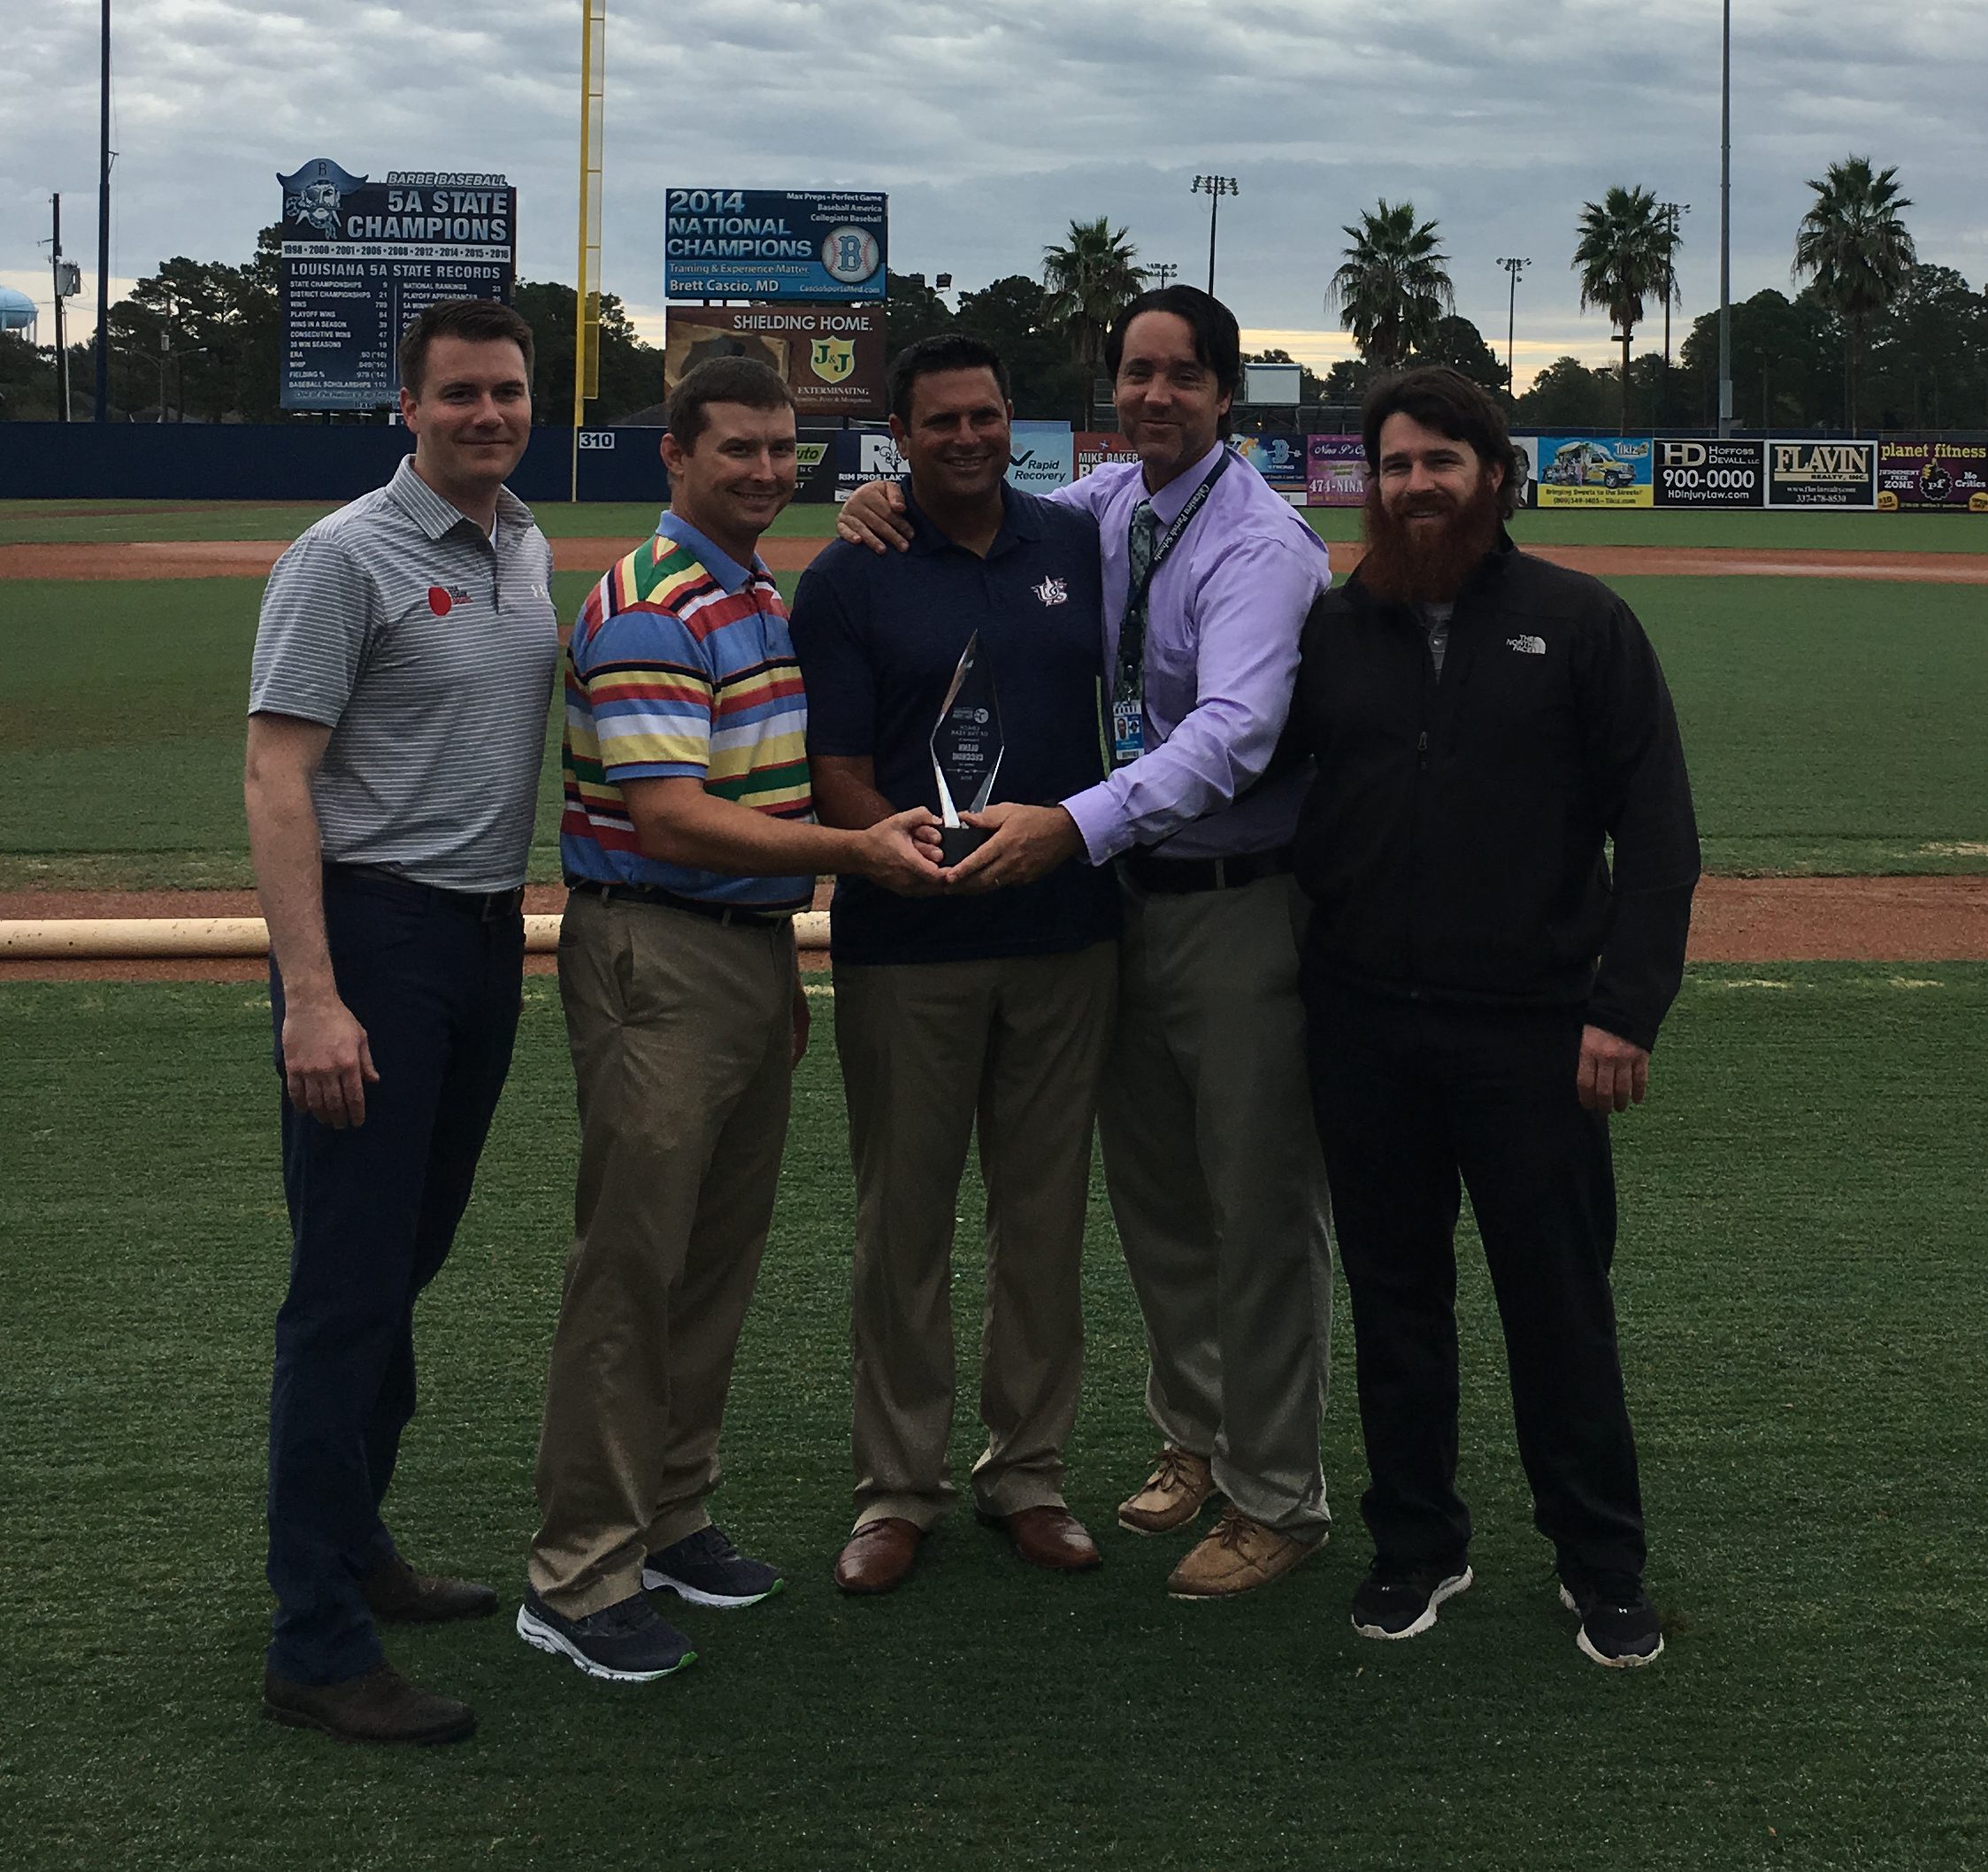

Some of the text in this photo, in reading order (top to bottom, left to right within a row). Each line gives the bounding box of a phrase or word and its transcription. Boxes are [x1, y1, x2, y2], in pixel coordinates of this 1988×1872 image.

[388, 172, 507, 187] BARBE BASEBALL
[388, 190, 507, 214] 5A STATE
[669, 191, 745, 214] 2014
[803, 193, 826, 202] Preps
[832, 193, 858, 202] Perfect
[817, 203, 849, 212] Baseball
[810, 214, 882, 223] Collegiate Baseball
[347, 216, 506, 242] CHAMPIONS
[668, 218, 793, 235] NATIONAL
[284, 244, 303, 255] 1998
[336, 245, 355, 256] 2001
[414, 247, 434, 257] 2012
[439, 248, 458, 257] 2014
[465, 248, 483, 258] 2015
[490, 249, 509, 259] 2016
[667, 239, 812, 257] CHAMPIONS
[838, 235, 863, 272] B
[292, 264, 501, 280] LOUISIANA 5A STATE RECORDS
[670, 264, 708, 274] Training
[711, 264, 719, 272] &
[720, 264, 775, 274] Experience
[670, 280, 779, 293] Brett Cascio, MD
[733, 315, 873, 331] SHIELDING HOME.
[798, 387, 869, 395] EXTERMINATING
[580, 433, 612, 448] 310
[796, 447, 819, 459] uto
[1315, 445, 1336, 455] Nina
[1657, 442, 1707, 467] HD
[1881, 442, 1986, 460] planet fitness
[1078, 453, 1138, 464] MIKE BAKER
[1775, 446, 1869, 472] FLAVIN
[1028, 460, 1060, 472] Rapid
[1014, 471, 1066, 483] Recovery
[1663, 470, 1755, 488] 900-0000
[1955, 480, 1986, 488] Critics
[1309, 480, 1364, 493] 474-NINA
[1928, 479, 1946, 490] pf
[1667, 490, 1750, 500] HDInjuryLaw.com
